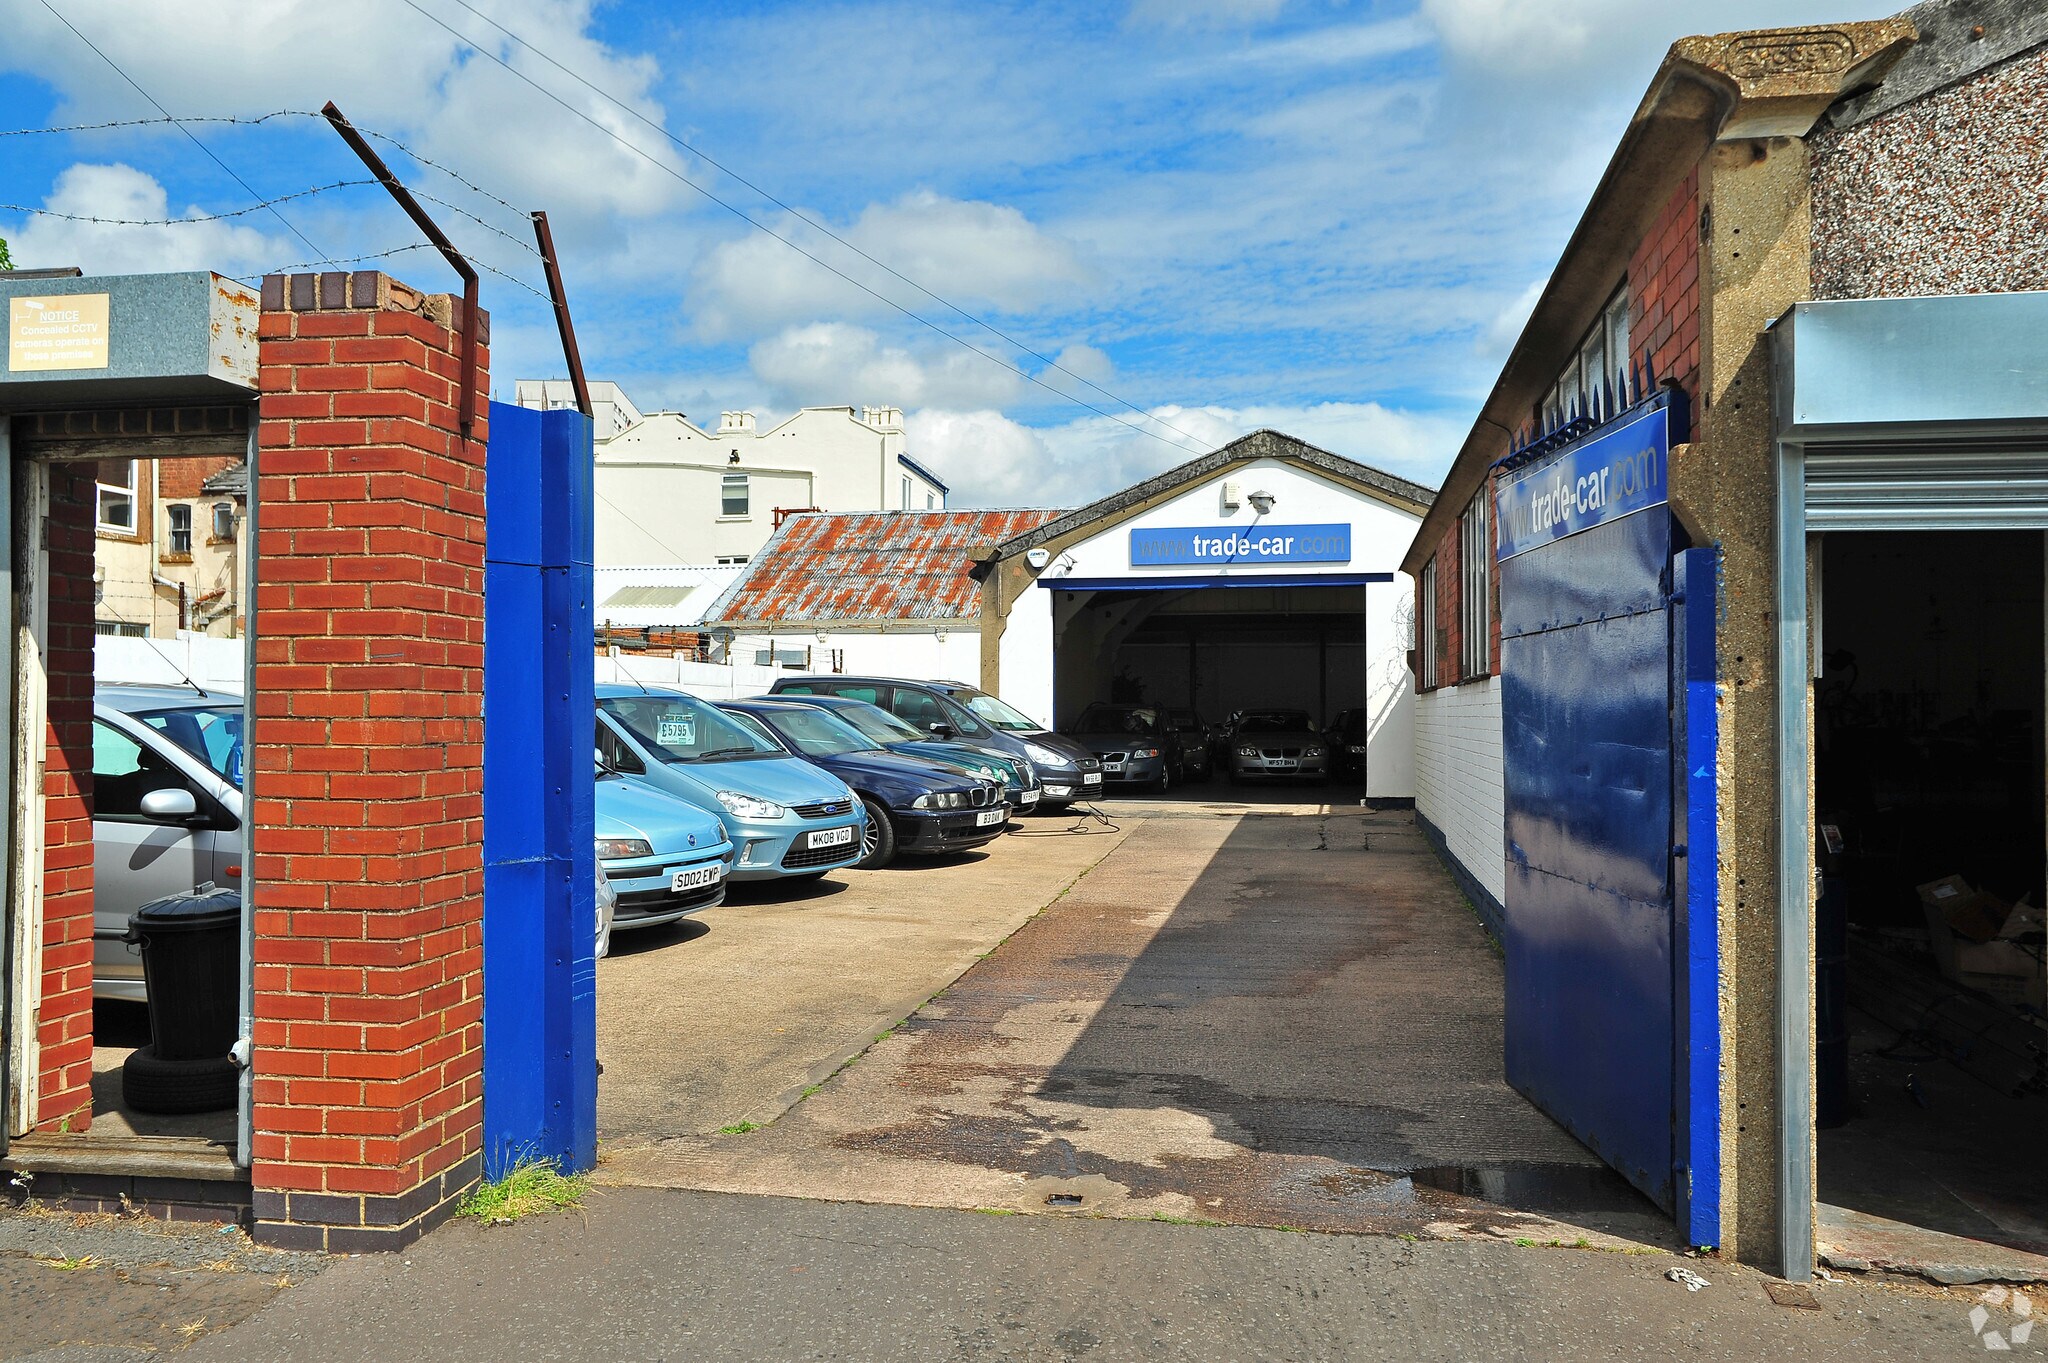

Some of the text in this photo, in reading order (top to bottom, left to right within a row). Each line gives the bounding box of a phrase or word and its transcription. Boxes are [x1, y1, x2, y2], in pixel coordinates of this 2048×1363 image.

[39, 310, 80, 322] NOTICE
[21, 323, 98, 336] Concealed CCTV
[14, 336, 104, 349] cameras operate on
[1138, 532, 1345, 558] www.trade-car.com
[661, 723, 687, 738] £5795
[812, 829, 850, 846] MK08 VGD
[676, 866, 719, 888] SD02 EWP
